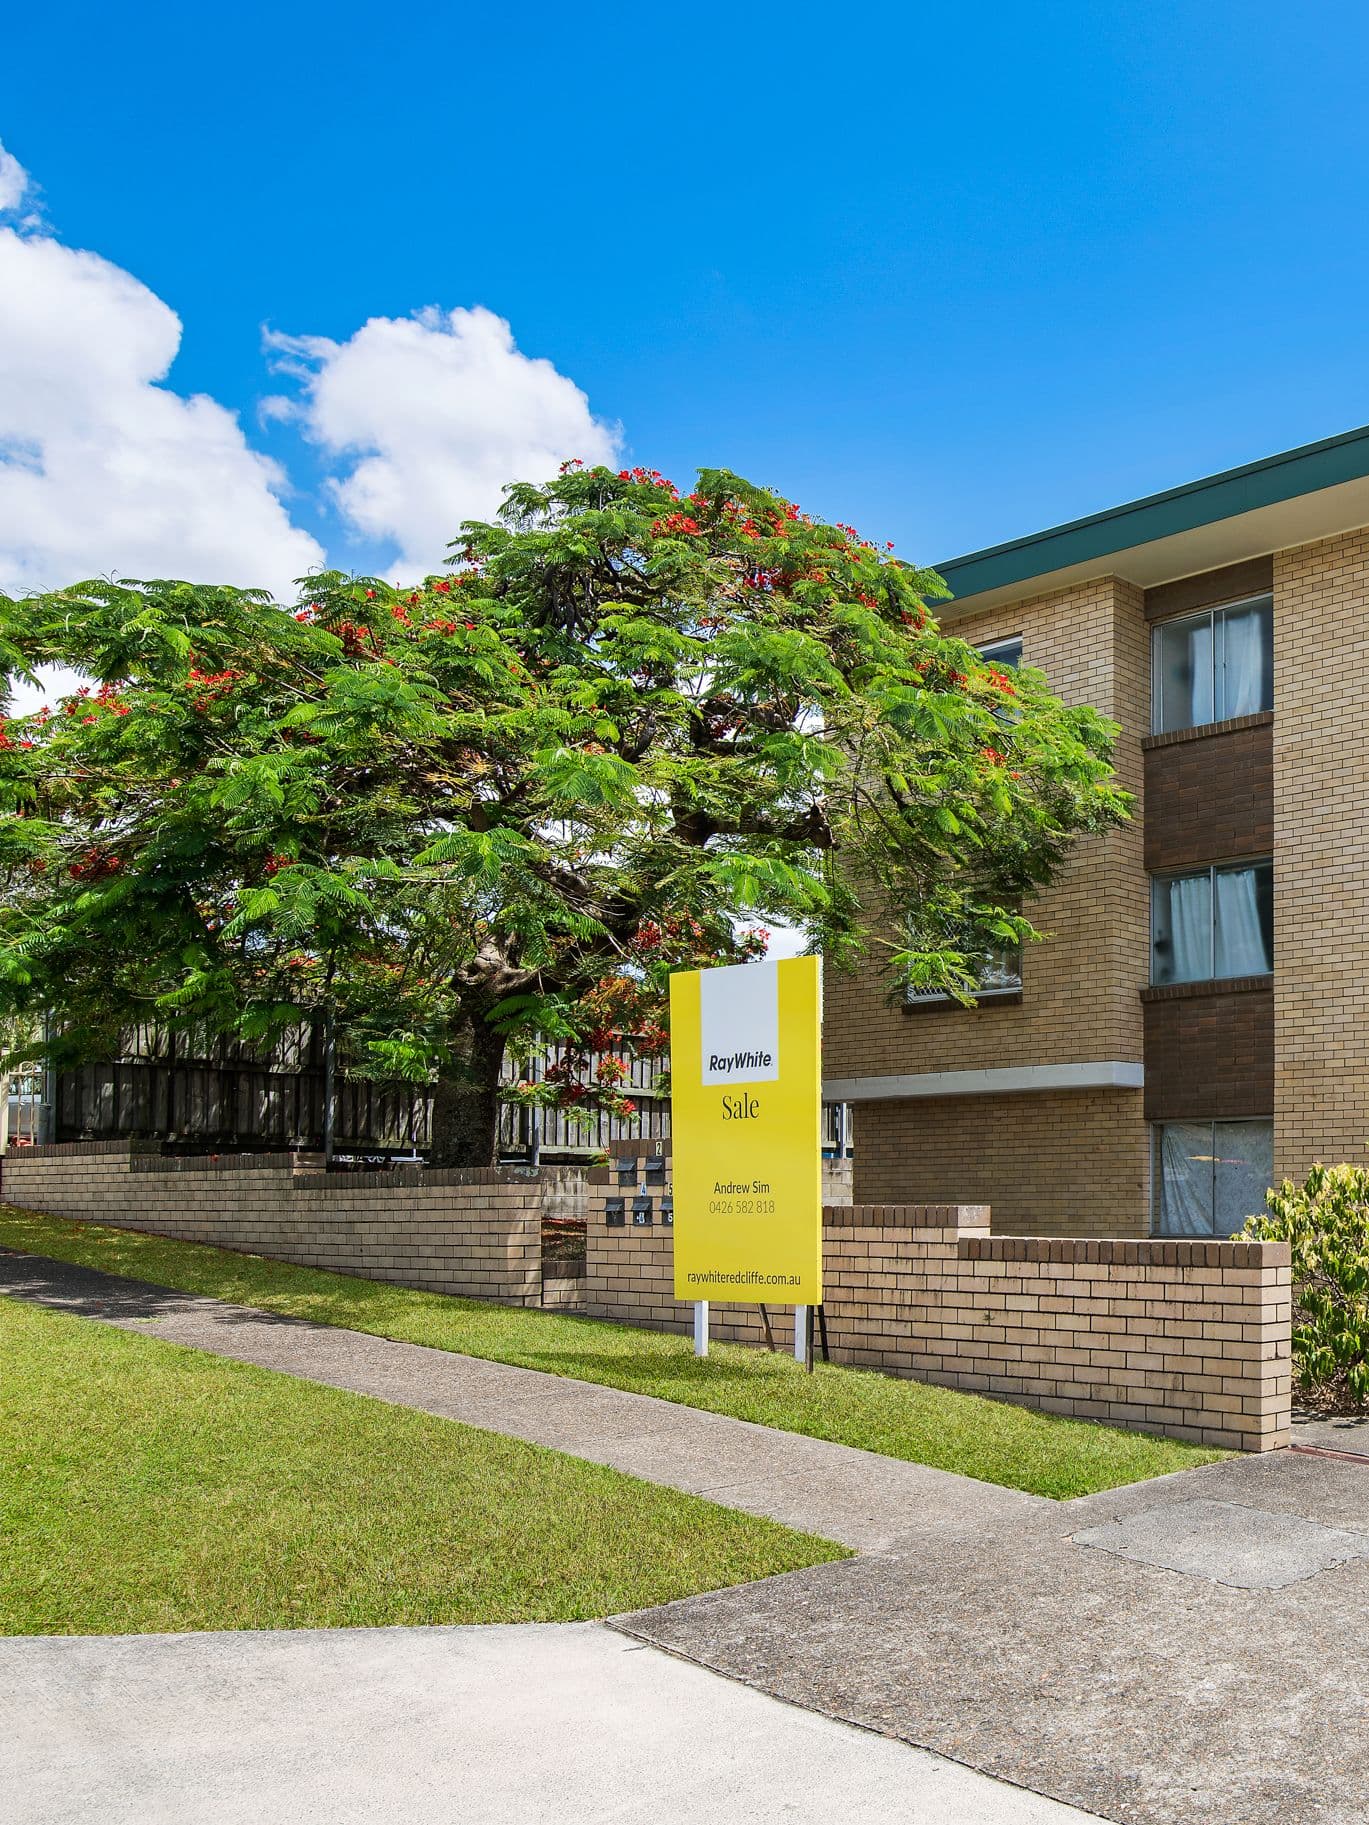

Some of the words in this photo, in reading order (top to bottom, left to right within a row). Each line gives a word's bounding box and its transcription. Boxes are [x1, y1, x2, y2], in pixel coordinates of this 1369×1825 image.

[709, 1051, 772, 1073] RayWhite
[722, 1092, 760, 1121] Sale
[714, 1181, 750, 1194] Andrew
[752, 1180, 770, 1194] Sim
[709, 1201, 733, 1214] 0426
[736, 1200, 754, 1214] 582
[756, 1200, 775, 1214] 818
[687, 1270, 801, 1286] raywhiteredcliffe.com.au
